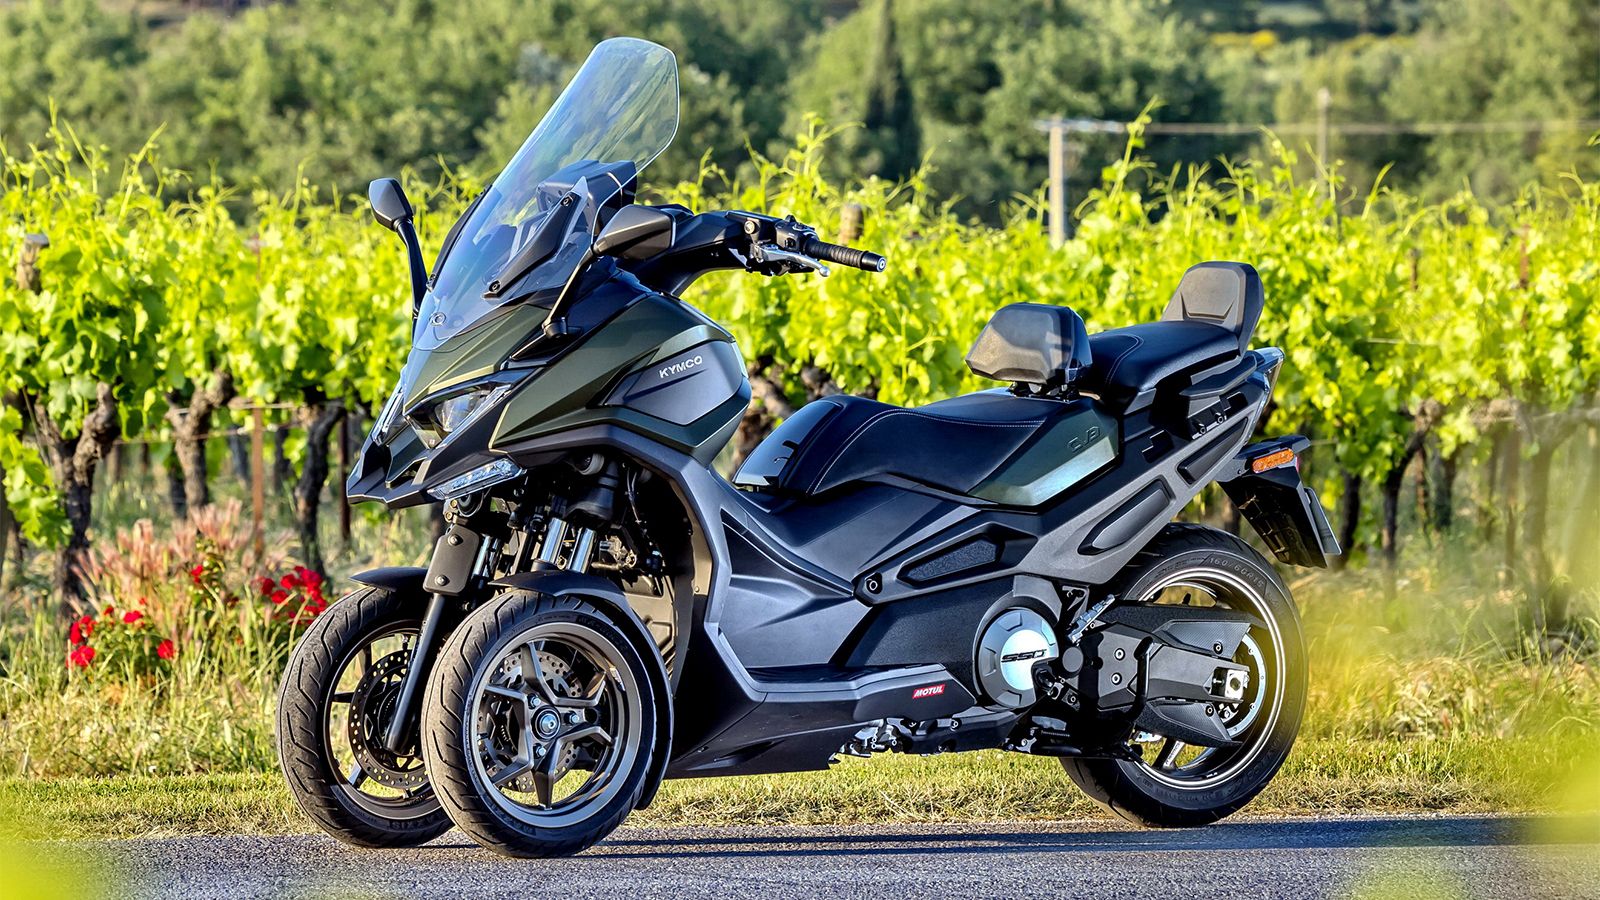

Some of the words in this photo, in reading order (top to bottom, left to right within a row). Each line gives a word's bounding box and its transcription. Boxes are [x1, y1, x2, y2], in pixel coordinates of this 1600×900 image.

[659, 355, 703, 379] KYMCO
[1001, 648, 1047, 663] 550
[913, 685, 943, 698] MOTUL
